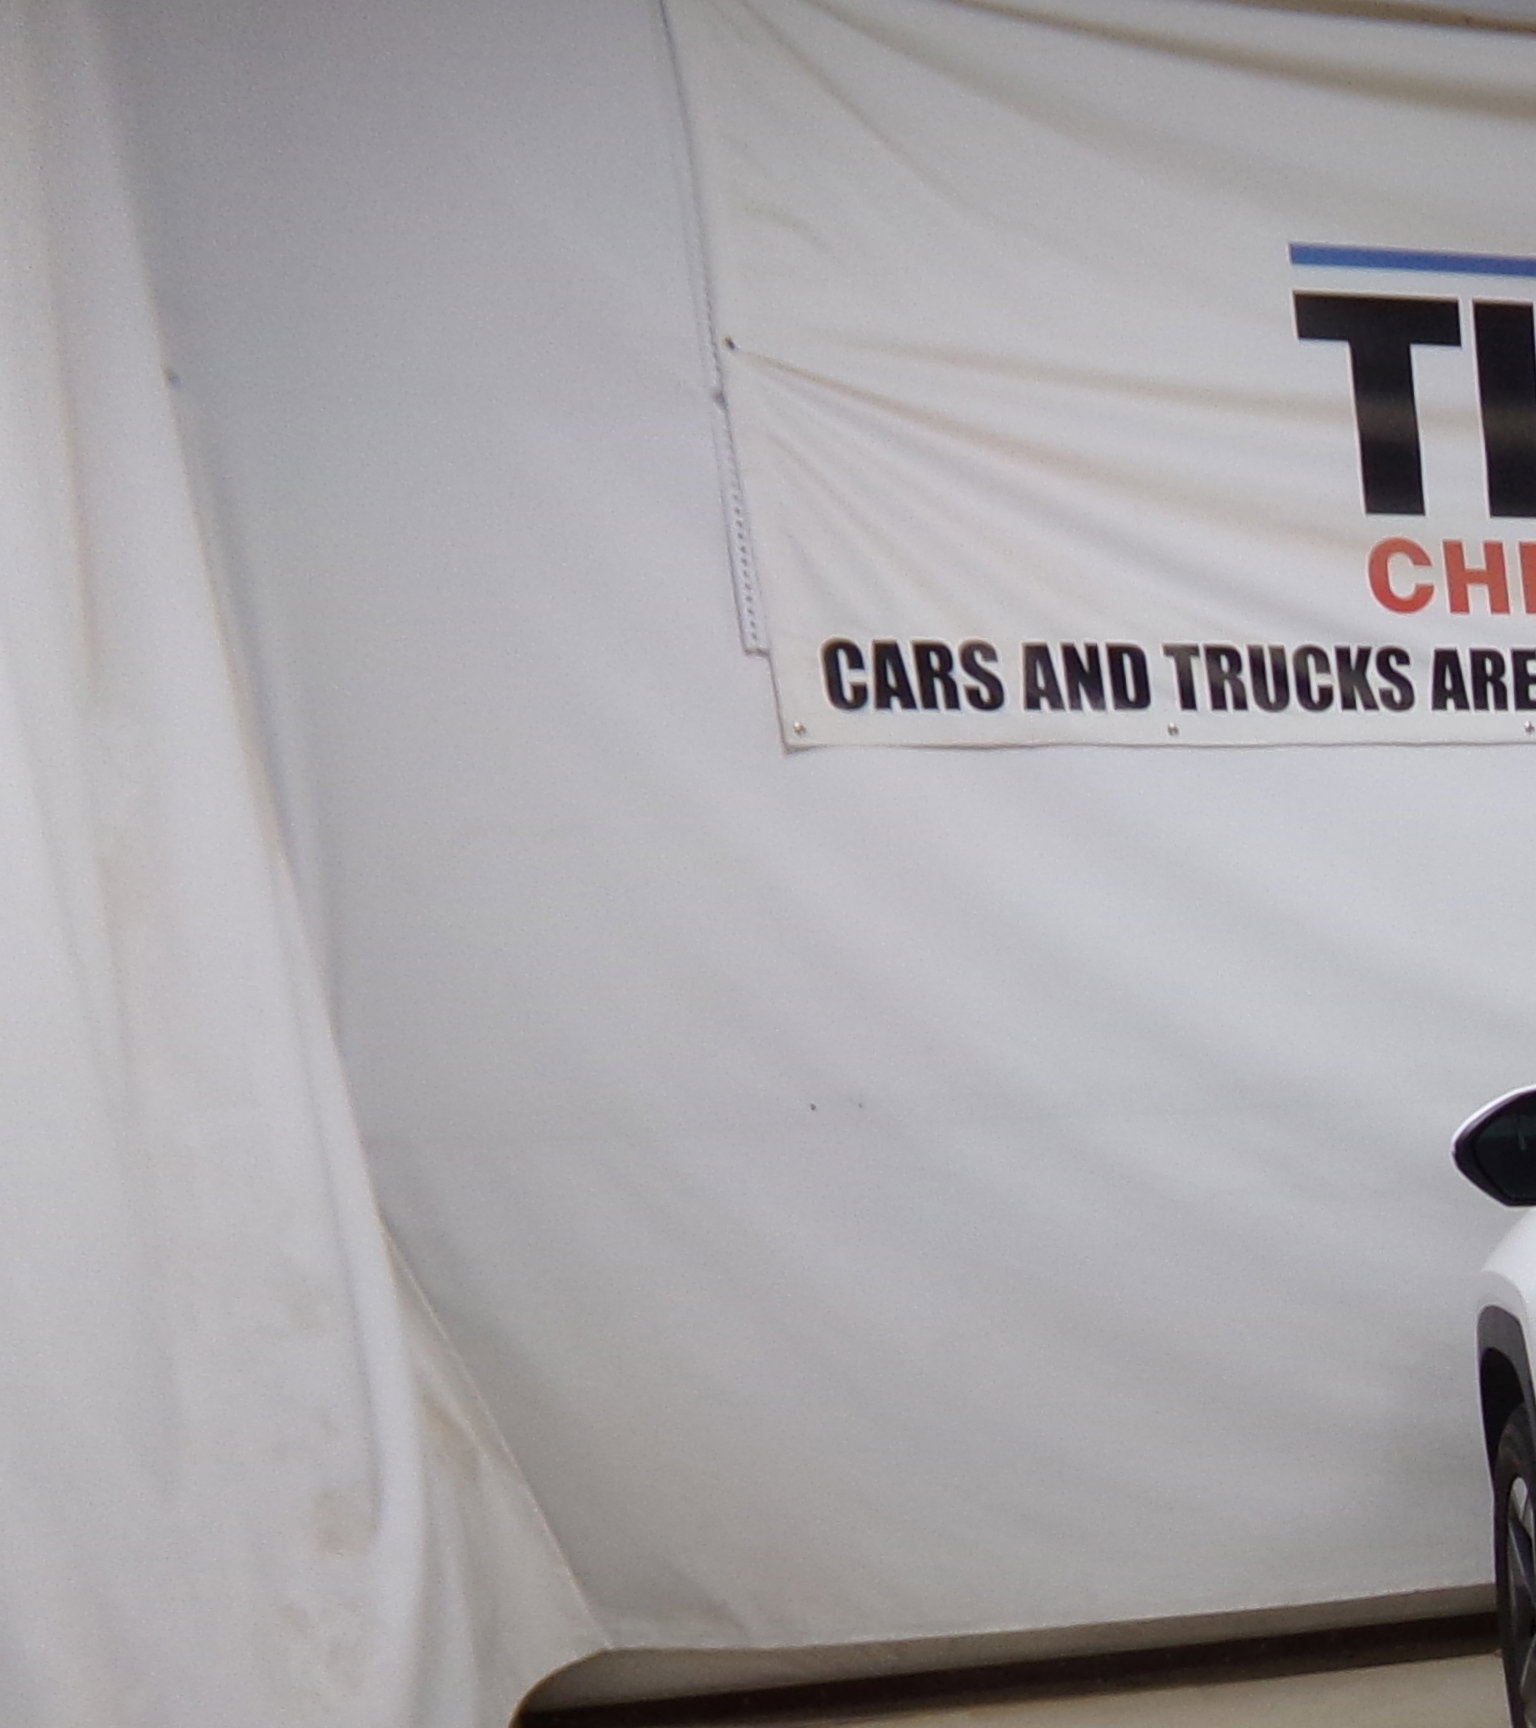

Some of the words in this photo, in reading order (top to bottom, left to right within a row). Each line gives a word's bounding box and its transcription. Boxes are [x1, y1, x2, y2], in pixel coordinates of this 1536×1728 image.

[820, 638, 1006, 712] CARS
[1020, 640, 1153, 712] AND
[1163, 642, 1417, 713] TRUCKS
